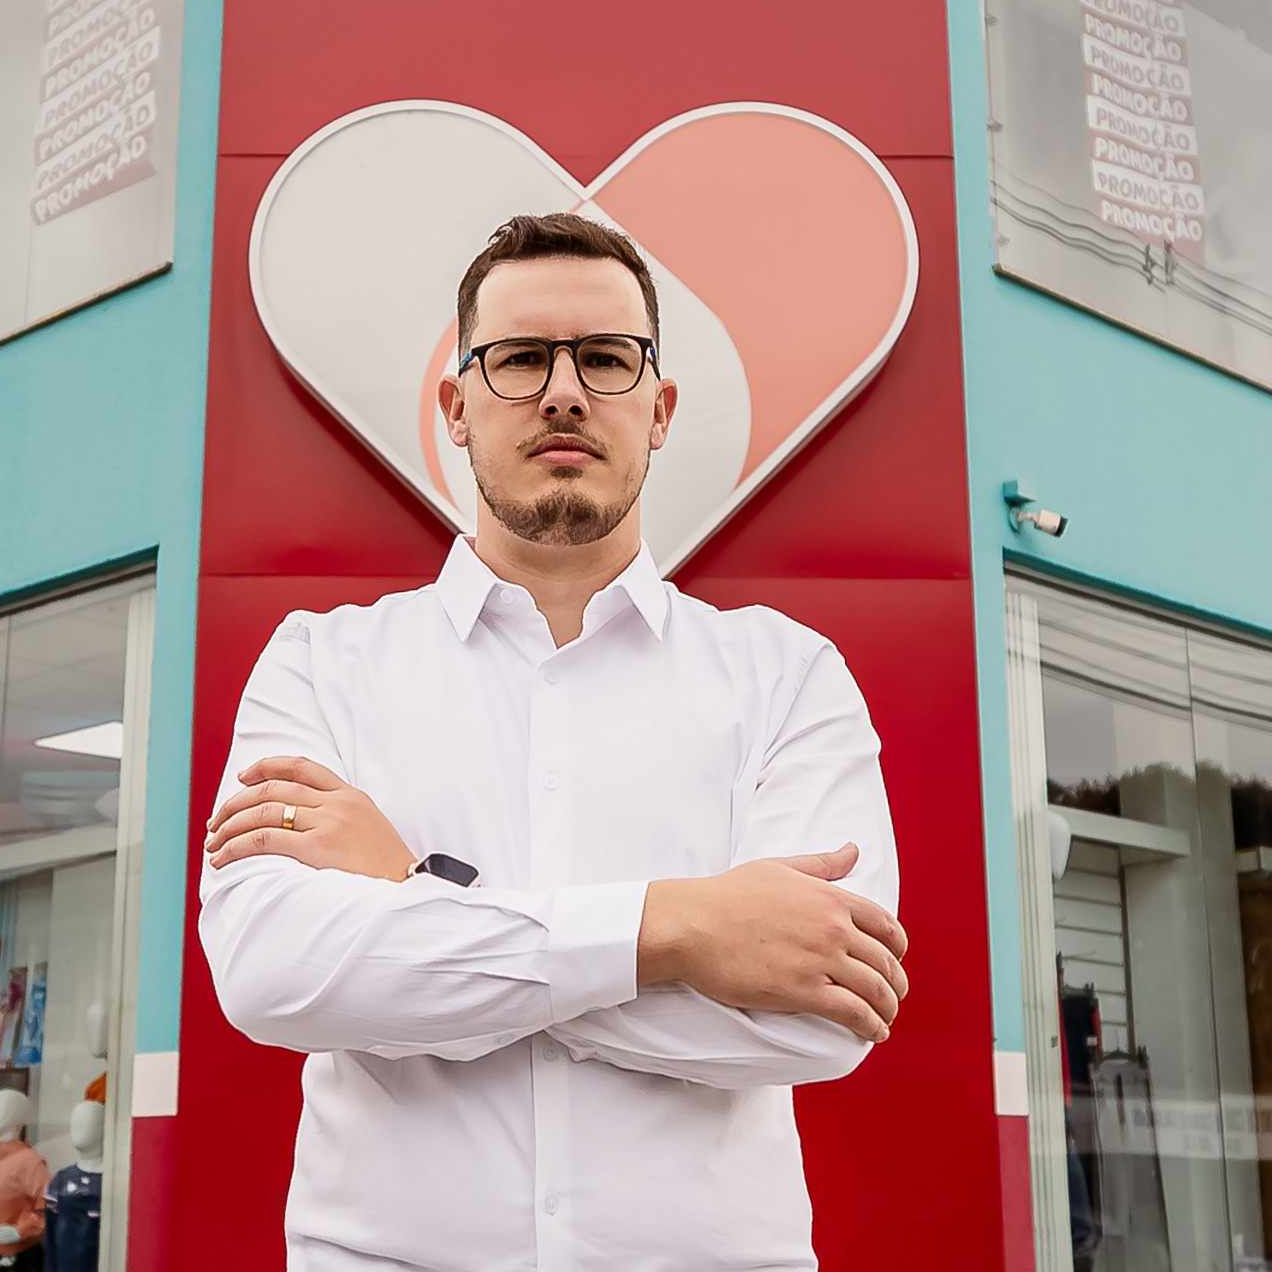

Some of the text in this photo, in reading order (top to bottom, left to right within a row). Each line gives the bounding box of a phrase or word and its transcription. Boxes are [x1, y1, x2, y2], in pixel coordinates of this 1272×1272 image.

[1085, 13, 1182, 62] PROMOÇÃO
[1091, 44, 1185, 92] PROMOÇÃO
[1092, 73, 1188, 122] PROMOÇÃO
[1096, 106, 1190, 152] PROMOÇÃO
[1095, 136, 1195, 182] PROMOÇÃO
[1098, 171, 1200, 211] PROMOÇÃO
[1101, 199, 1203, 243] PROMOÇÃO
